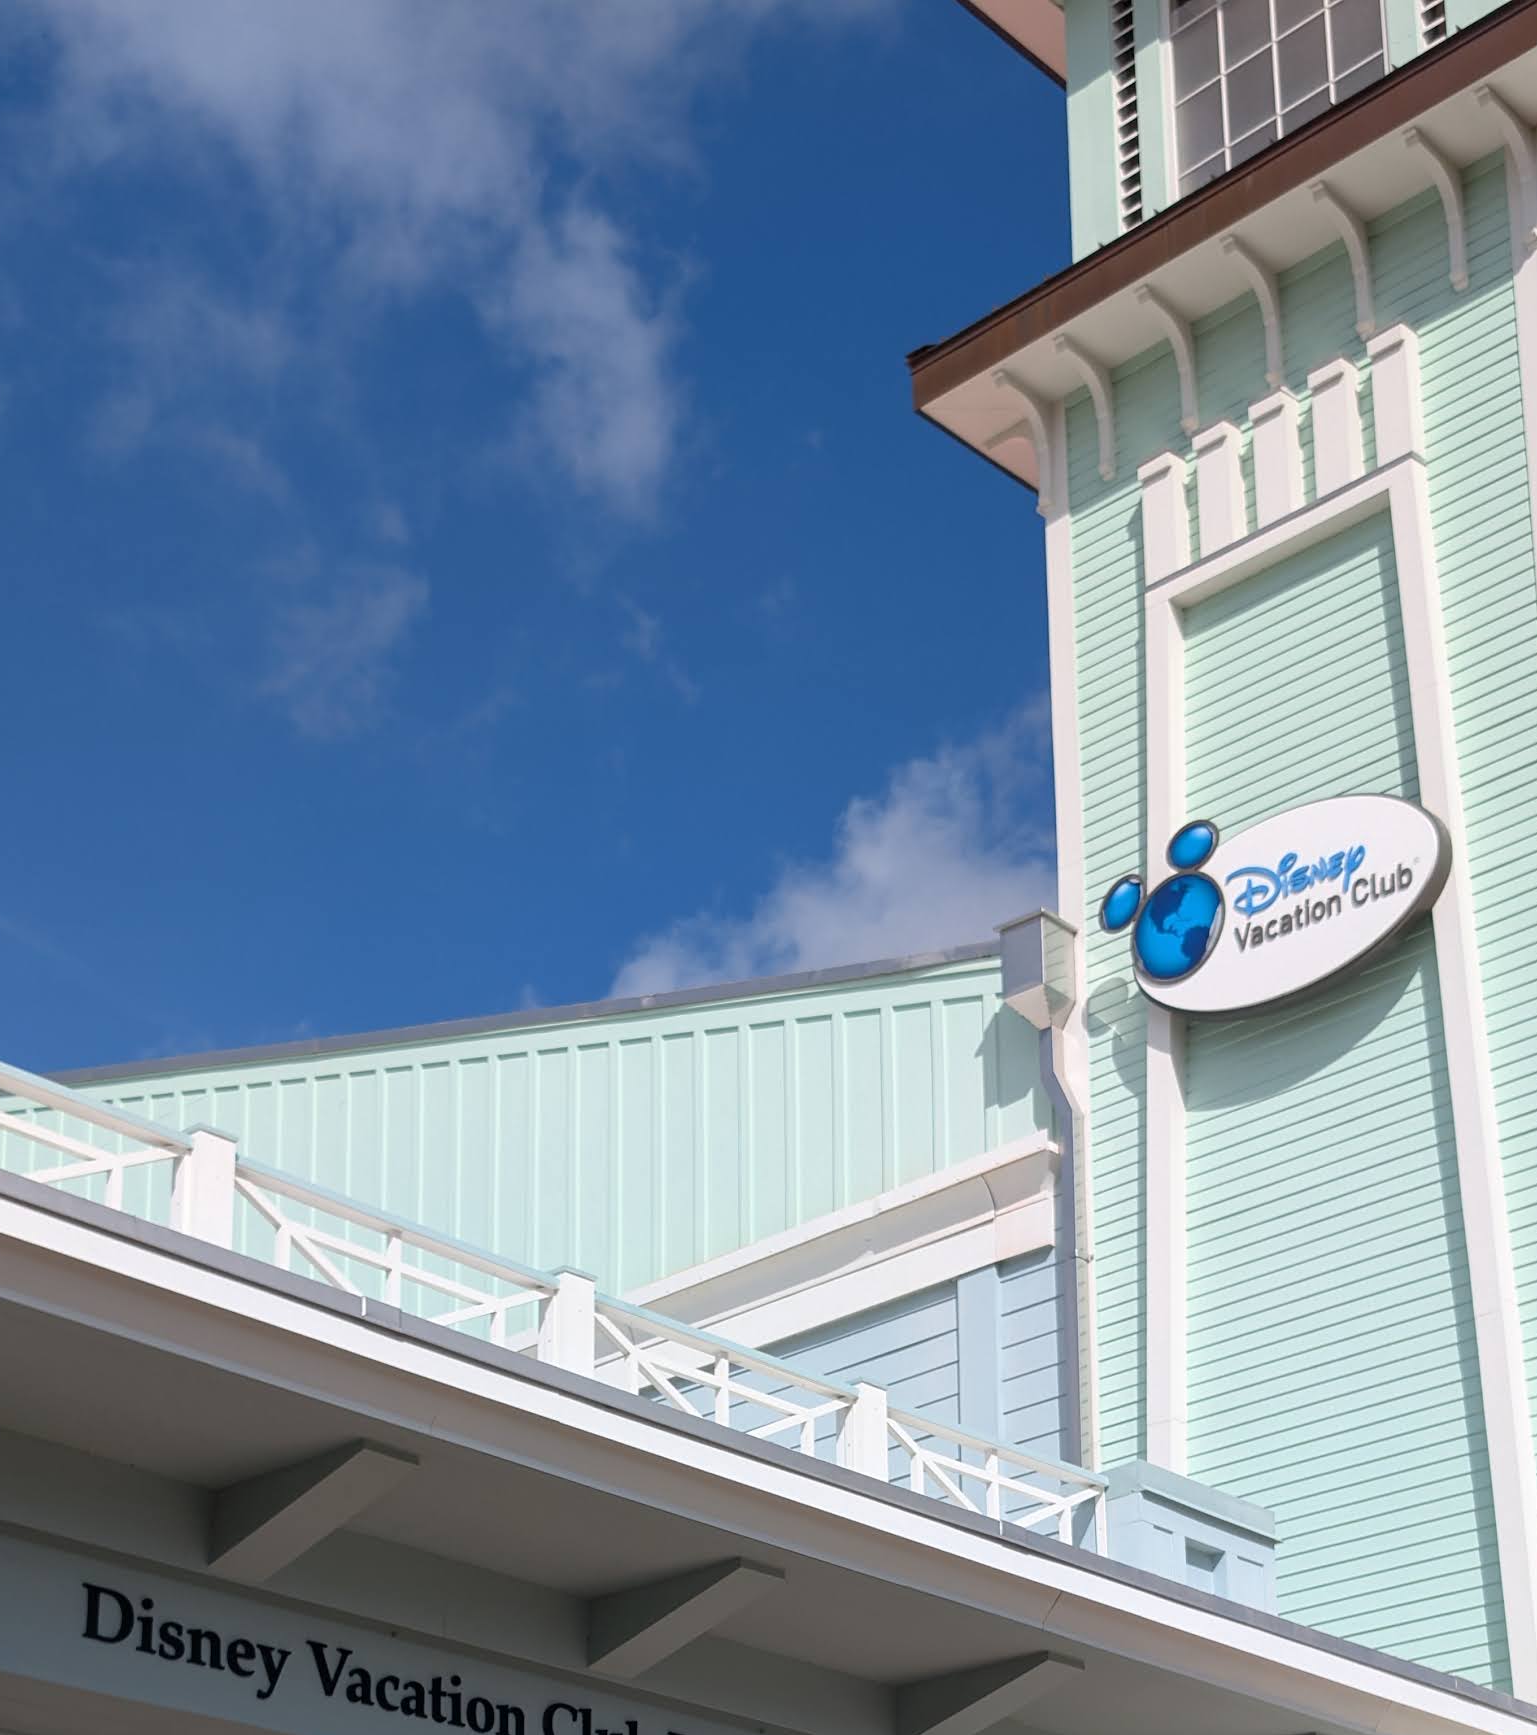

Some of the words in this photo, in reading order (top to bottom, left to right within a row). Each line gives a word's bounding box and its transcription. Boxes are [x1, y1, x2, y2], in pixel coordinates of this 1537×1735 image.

[1224, 844, 1366, 919] Disney
[1233, 895, 1341, 954] Vacation
[1350, 863, 1414, 908] Club
[81, 1582, 292, 1700] Disney
